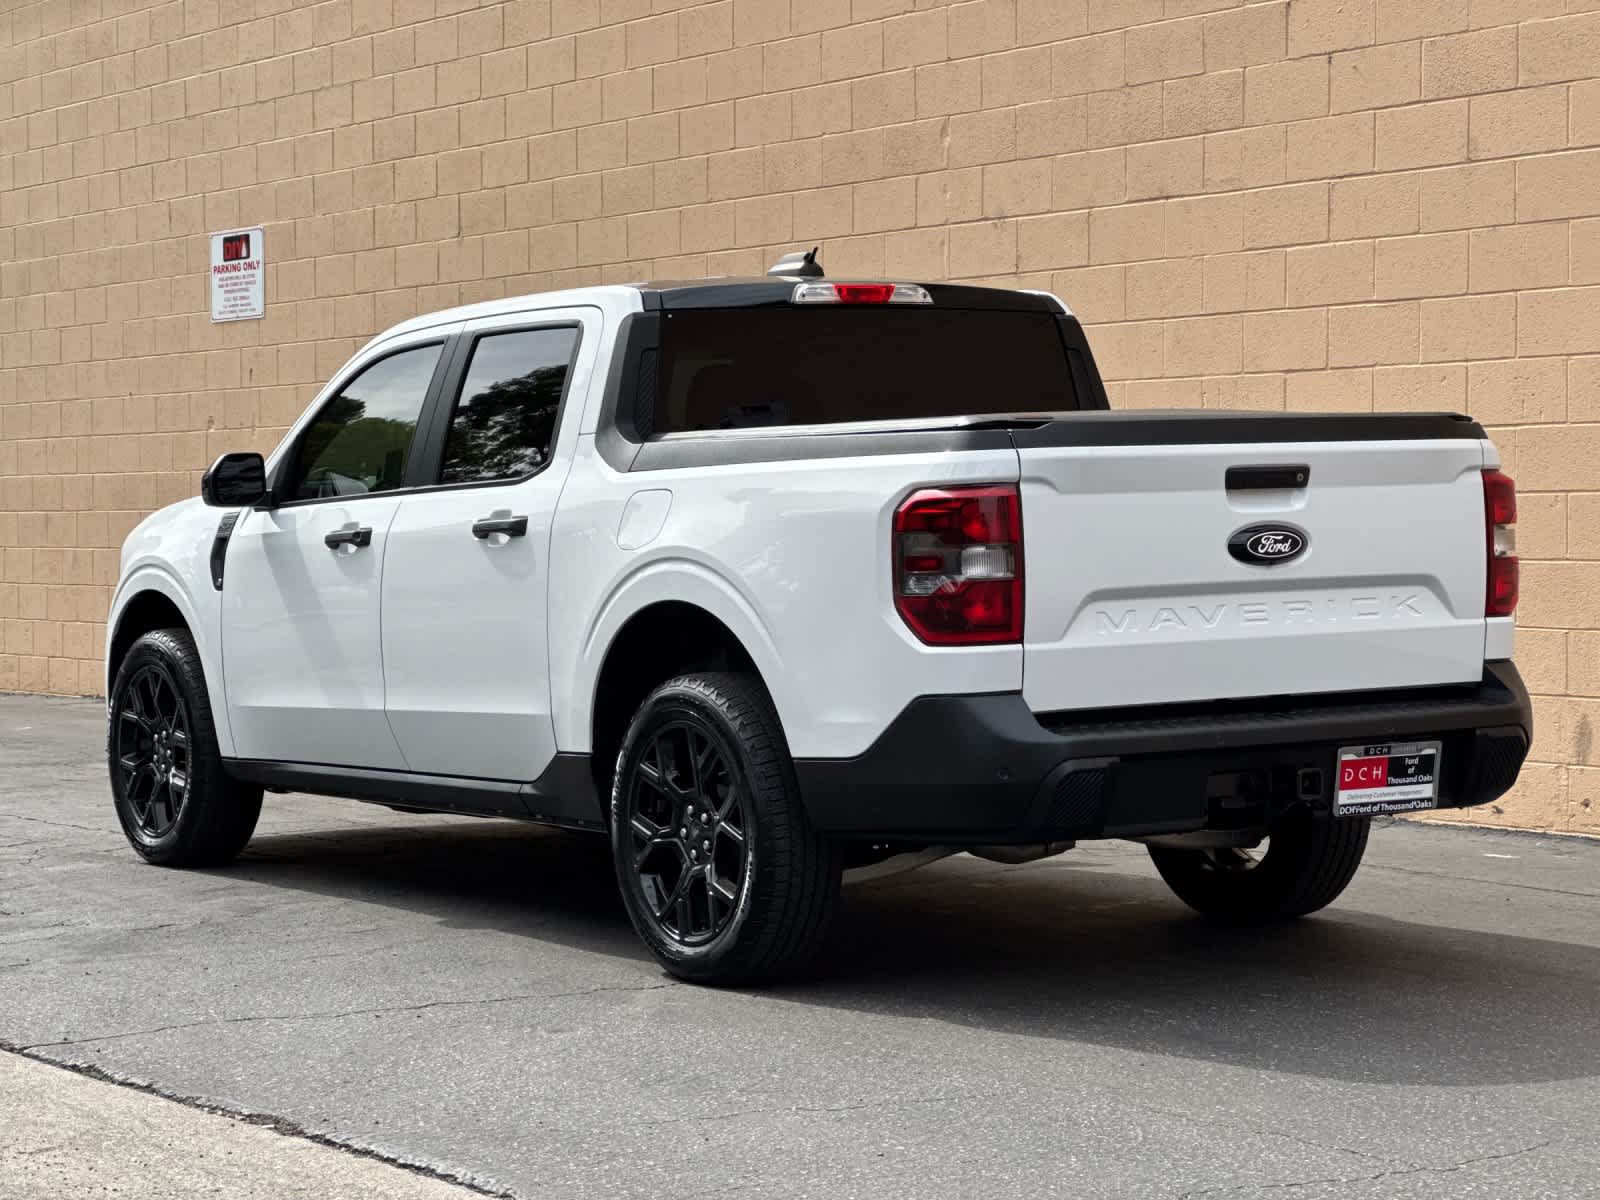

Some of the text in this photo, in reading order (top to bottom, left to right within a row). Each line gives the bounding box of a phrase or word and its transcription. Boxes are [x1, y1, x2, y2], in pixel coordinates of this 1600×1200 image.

[213, 260, 260, 274] PARKING ONLY
[1258, 535, 1291, 553] Ford
[1095, 593, 1425, 636] MAVERICK
[1405, 757, 1419, 765] Ford
[1408, 766, 1415, 774] of
[1388, 773, 1433, 785] Thousand Oaks
[1372, 803, 1380, 812] of
[1381, 802, 1413, 811] Thousand
